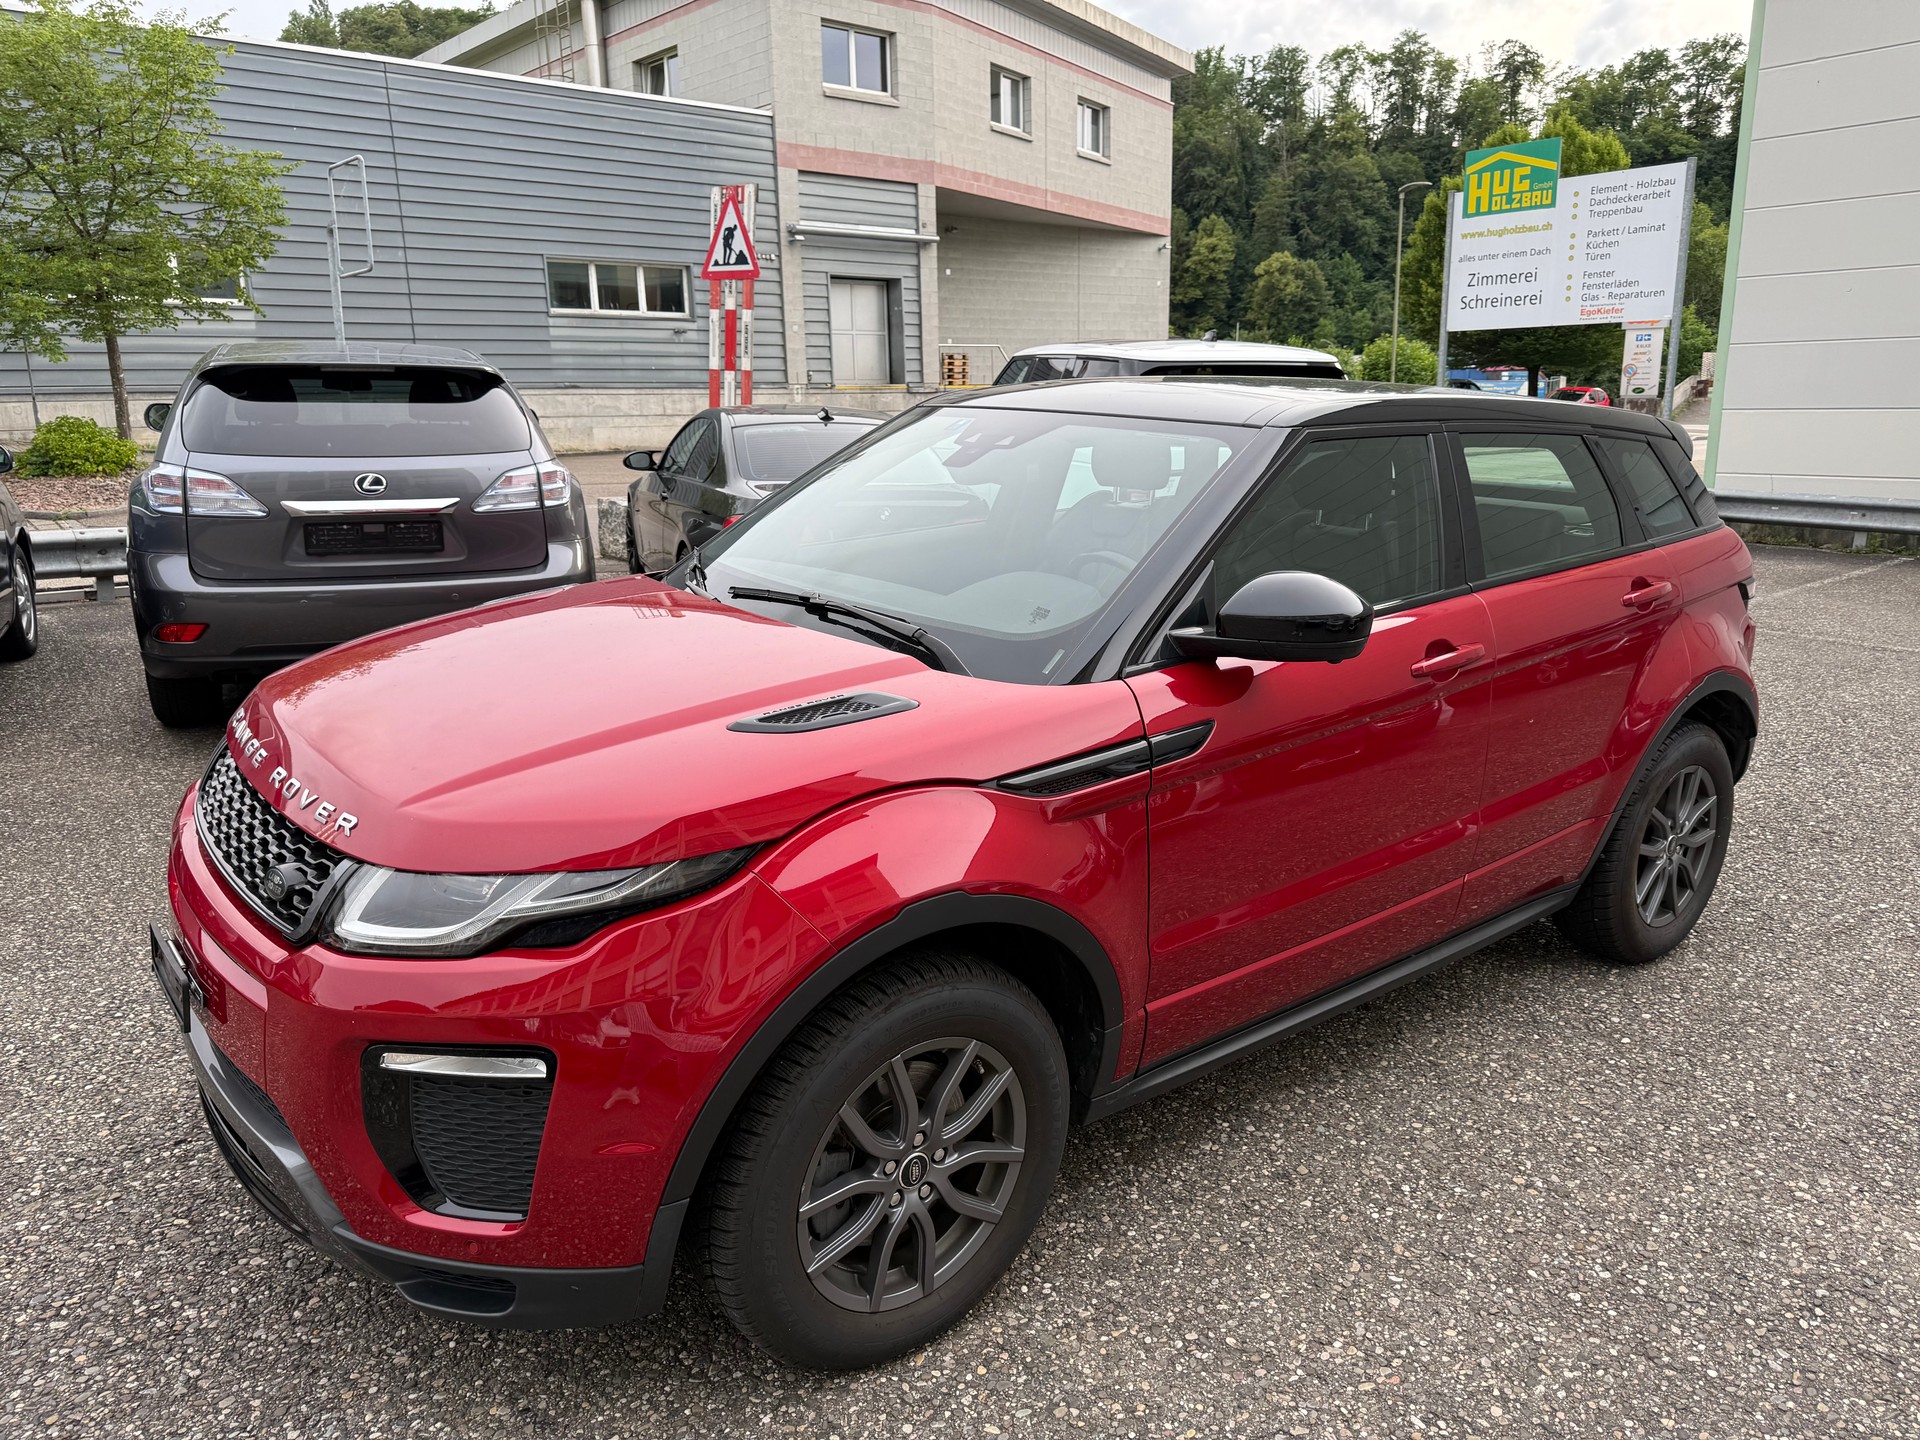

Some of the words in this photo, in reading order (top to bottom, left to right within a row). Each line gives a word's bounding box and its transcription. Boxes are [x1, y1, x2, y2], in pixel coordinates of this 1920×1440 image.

[1533, 181, 1553, 190] GmbH
[1590, 183, 1628, 195] Element
[1636, 178, 1676, 190] Holzbau
[1590, 189, 1671, 206] Dachdeckerarbeit
[1589, 206, 1643, 218] Treppenbau
[1461, 222, 1552, 240] www.hugholzbau.ch
[1587, 228, 1620, 238] Parkett
[1628, 223, 1666, 234] Laminat
[1586, 240, 1620, 250] Küchen
[1458, 255, 1476, 263] alles
[1478, 253, 1500, 261] unter
[1502, 250, 1528, 258] einem
[1530, 246, 1552, 256] Dach
[1585, 252, 1610, 261] Türen
[1467, 267, 1538, 287] Zimmerei
[1582, 269, 1615, 279] Fenster
[1582, 278, 1640, 290] Fensterläden
[1460, 290, 1542, 310] Schreinerei
[1581, 293, 1600, 302] Glas
[1608, 289, 1665, 300] Reparaturen
[1580, 306, 1624, 317] EgoKiefer
[232, 707, 268, 769] RANGE
[268, 766, 359, 837] ROVER
